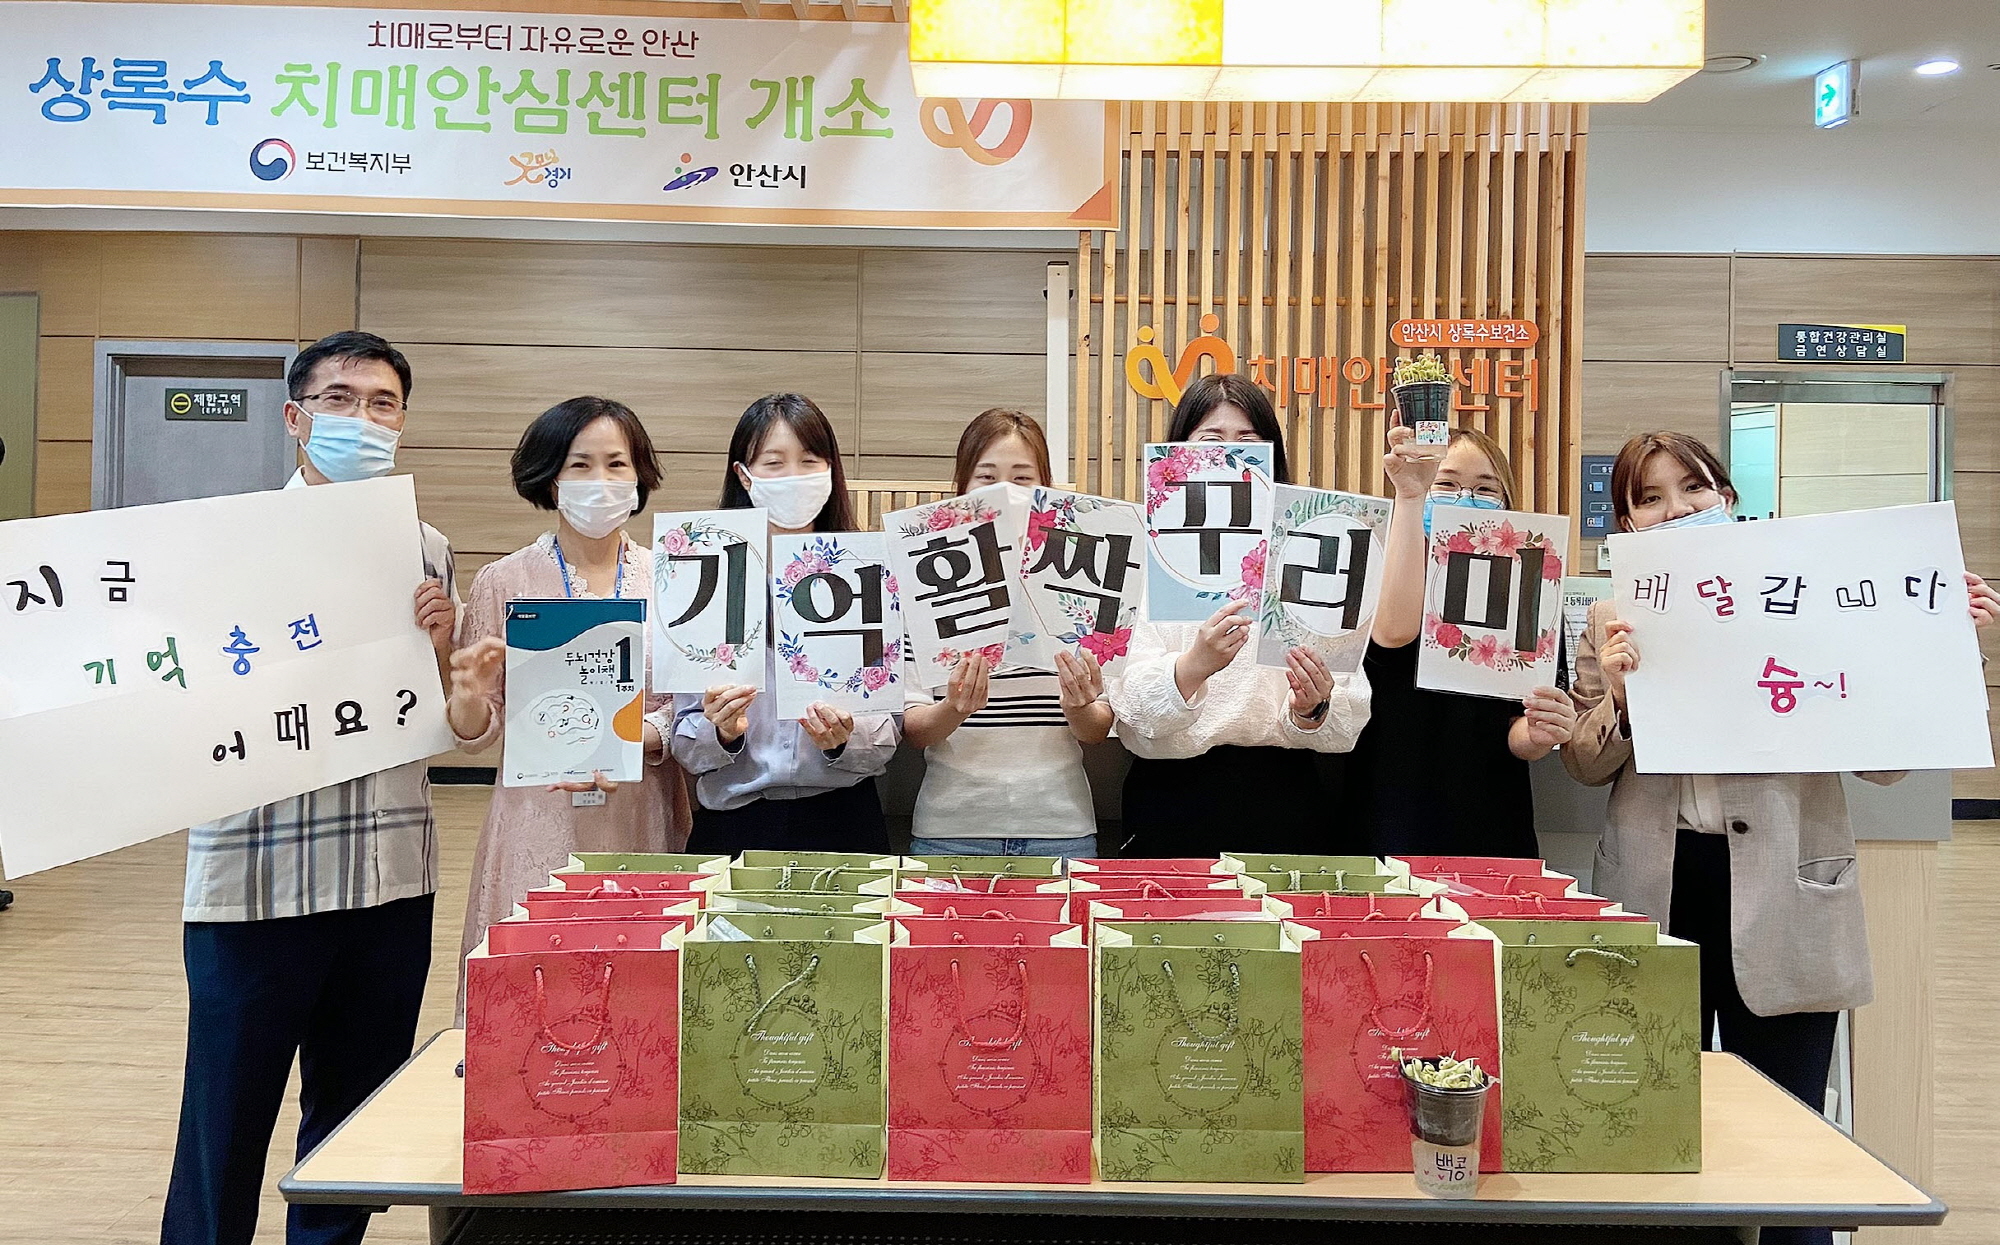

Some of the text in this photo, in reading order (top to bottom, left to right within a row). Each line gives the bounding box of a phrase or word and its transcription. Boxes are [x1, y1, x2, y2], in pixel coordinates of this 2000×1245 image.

[367, 21, 700, 58] 치매로부터 자유로운 안산
[28, 57, 895, 142] 상록수 치매안심센터 개소
[305, 151, 413, 174] 보건복지부
[729, 163, 808, 189] 안산시
[1401, 323, 1442, 342] 안산시
[1795, 330, 1888, 344] 통합건강관리실
[1246, 354, 1539, 412] 치매안센터
[193, 393, 241, 407] 제한구역
[565, 649, 615, 666] 두뇌건강
[615, 636, 635, 684] 1
[579, 665, 615, 685] 놀이책
[590, 1040, 609, 1055] gift
[750, 1030, 815, 1046] Thoughtful gift
[1171, 1036, 1236, 1052] Thoughtful gift
[1571, 1031, 1635, 1046] Thoughtful gift
[1435, 1151, 1467, 1182] 백콩
